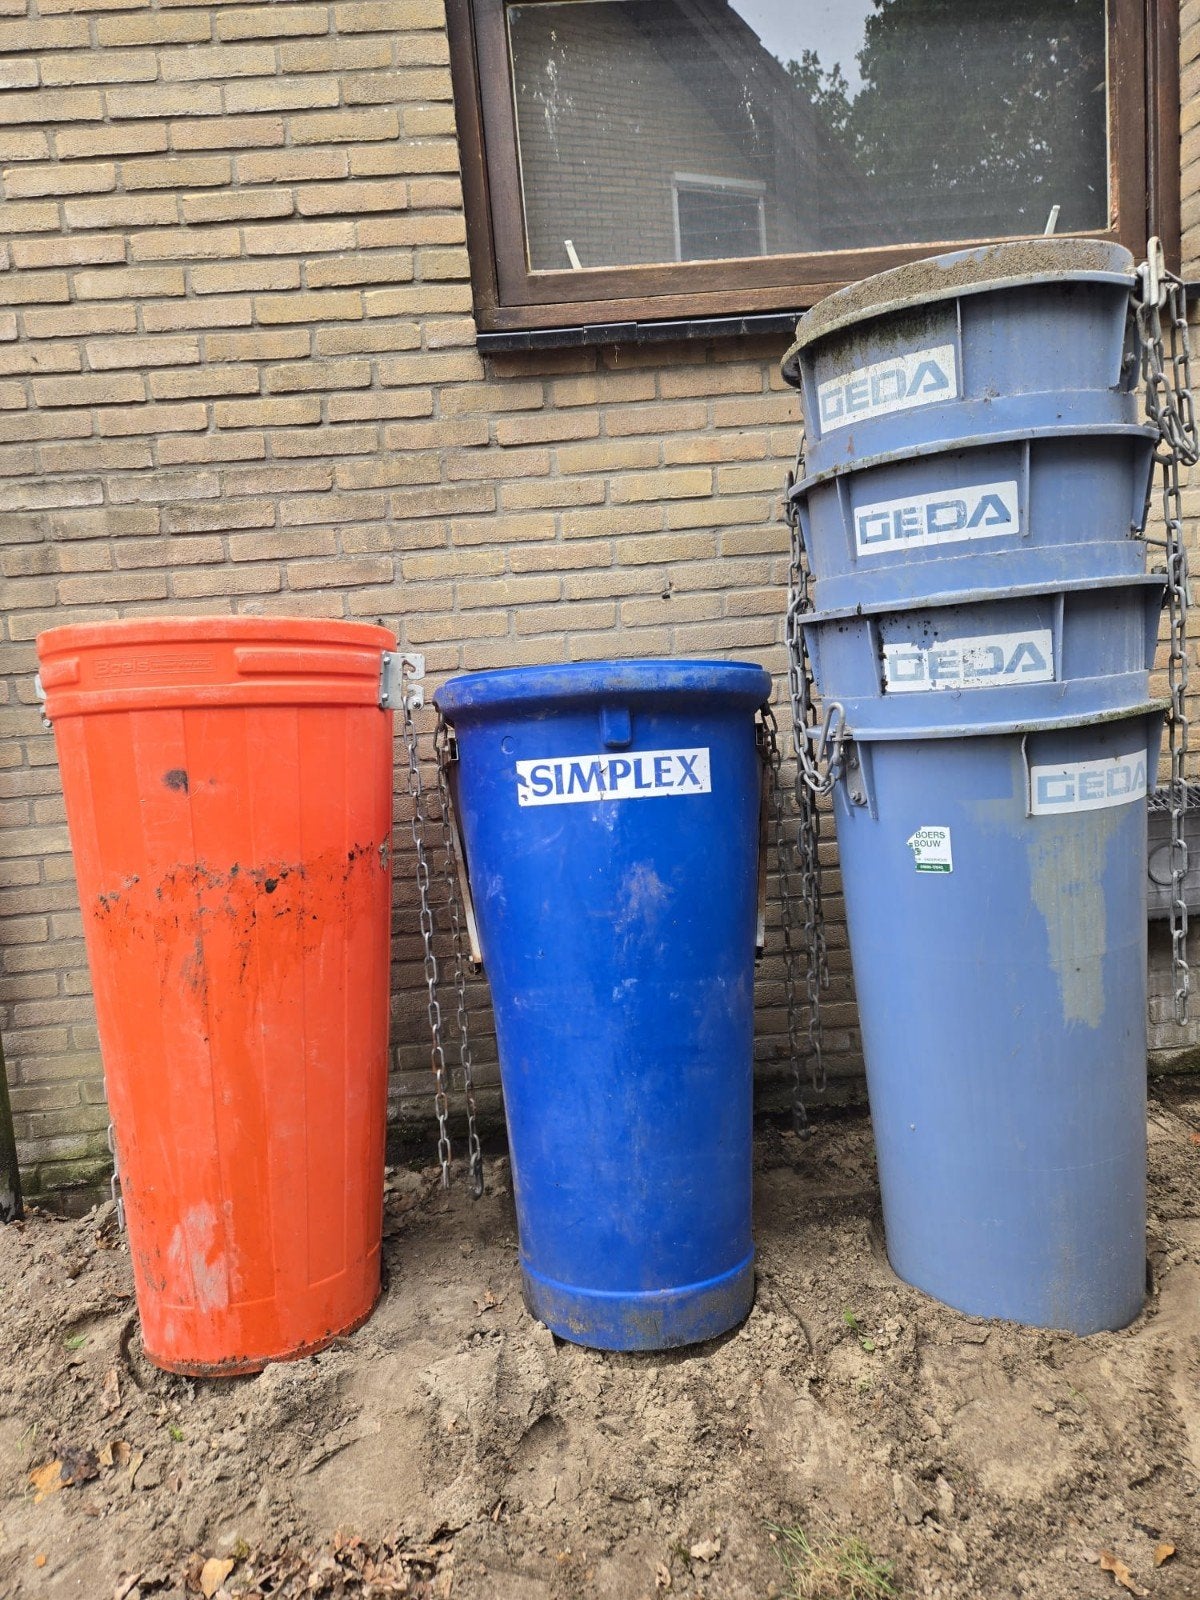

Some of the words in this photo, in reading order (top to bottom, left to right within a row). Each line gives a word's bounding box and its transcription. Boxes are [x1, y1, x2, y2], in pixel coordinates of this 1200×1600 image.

[820, 360, 949, 423] GEDA
[858, 493, 1011, 544] GEDA
[889, 641, 1047, 682] GEDA
[530, 754, 701, 797] SIMPLEX
[1037, 760, 1145, 805] GEDA
